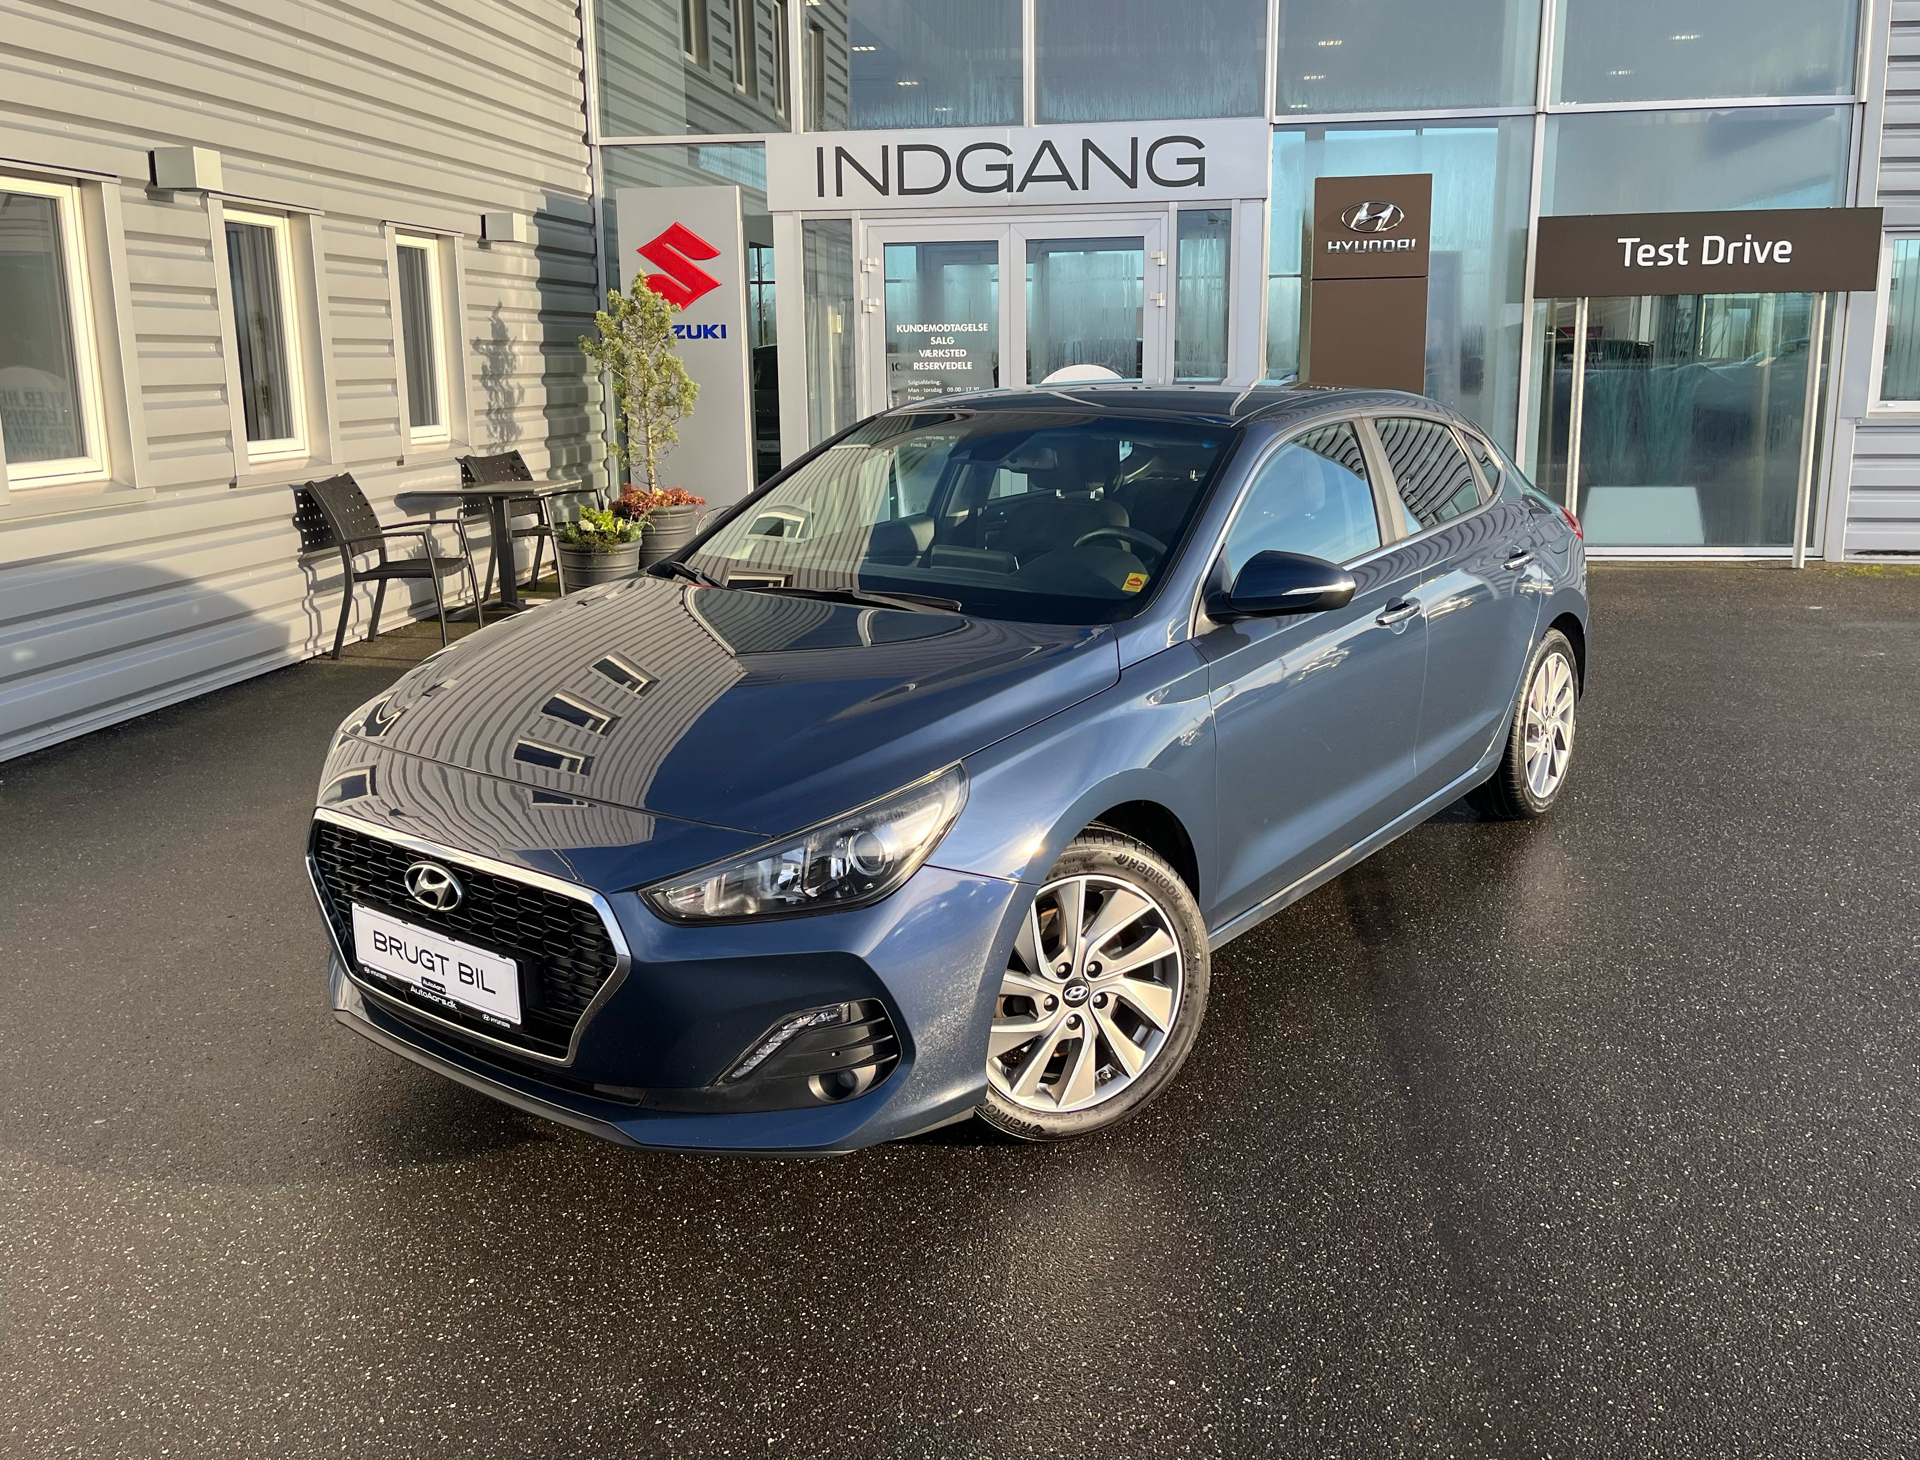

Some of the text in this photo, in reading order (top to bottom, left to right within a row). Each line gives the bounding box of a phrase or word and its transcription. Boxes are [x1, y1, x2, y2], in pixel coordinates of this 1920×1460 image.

[815, 135, 1206, 198] INDGANG
[1327, 238, 1417, 254] HYUNDAI
[1617, 233, 1793, 268] Test Drive
[662, 323, 727, 340] ZUKI
[896, 323, 989, 333] KUNDEMODTAGELSE
[930, 336, 955, 345] SALG
[919, 349, 967, 358] VÆRKSTED
[913, 362, 973, 371] RESERVEDELE
[372, 929, 497, 995] BRUGT BIL
[410, 985, 458, 1010] AutoAars.dk
